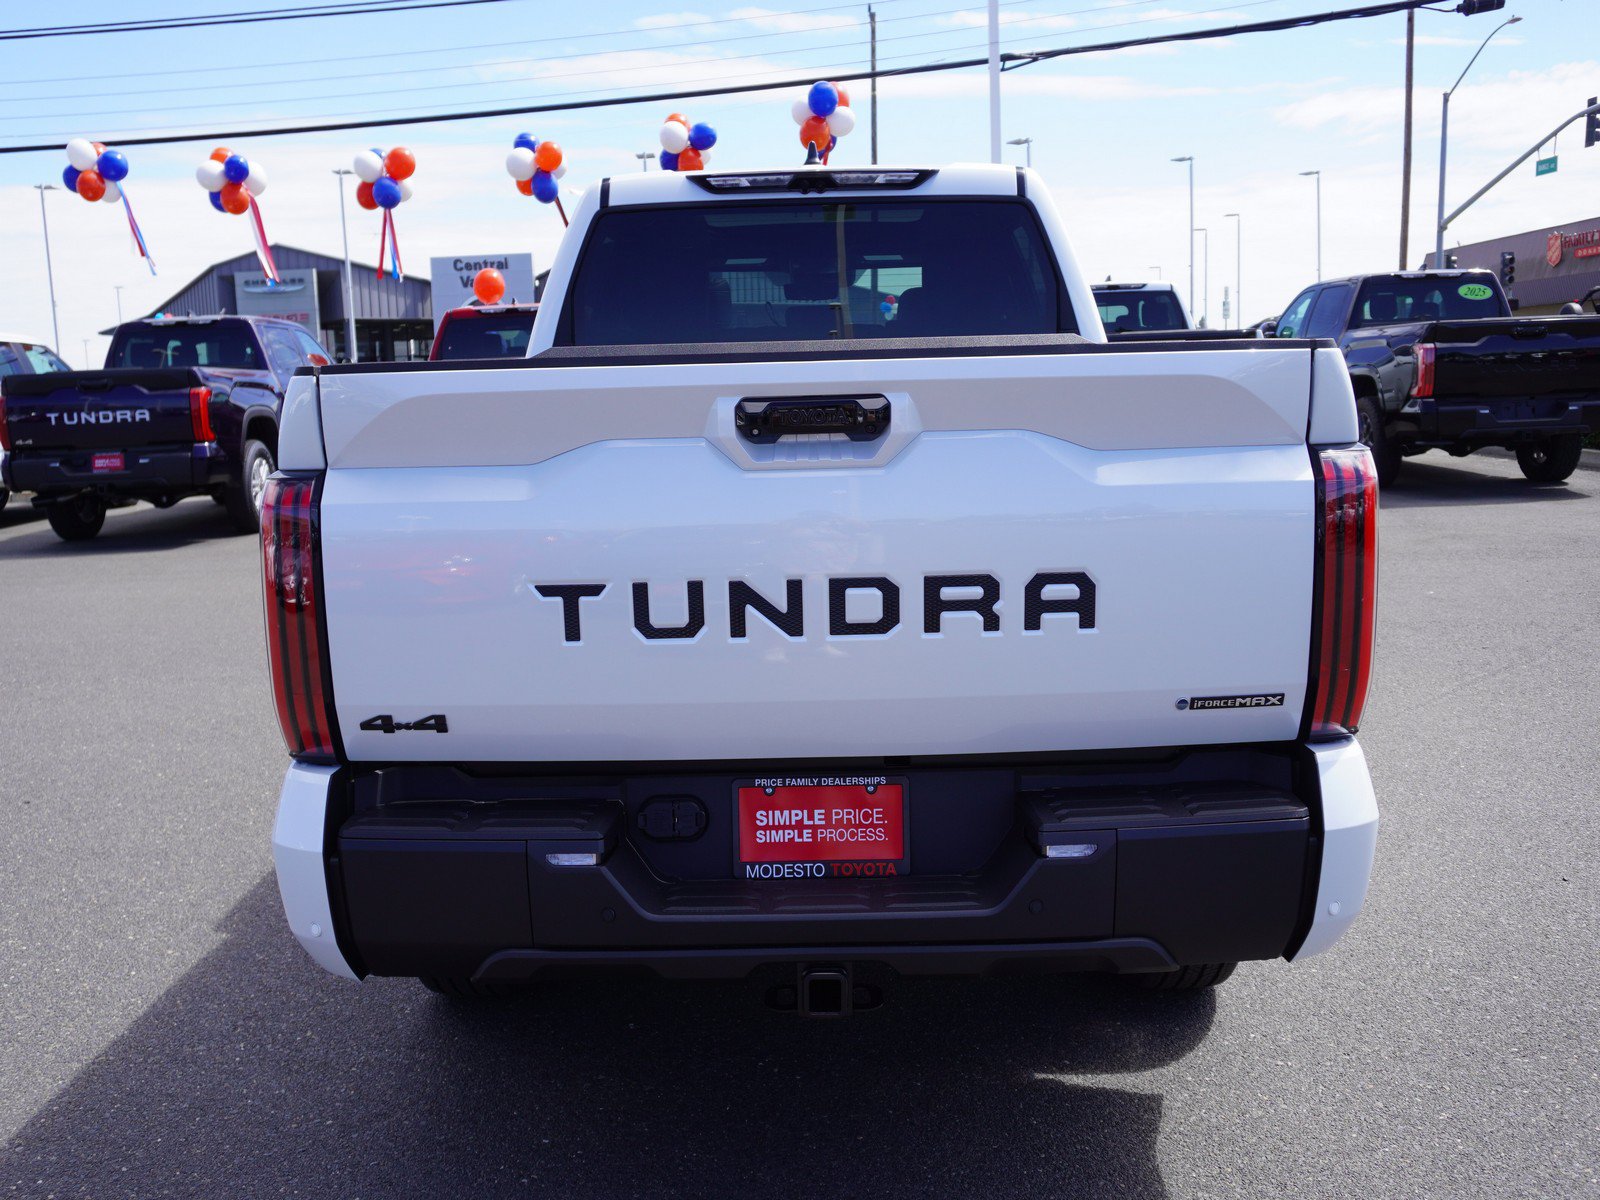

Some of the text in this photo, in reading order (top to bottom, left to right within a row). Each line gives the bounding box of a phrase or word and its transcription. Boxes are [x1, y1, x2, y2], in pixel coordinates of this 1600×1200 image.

[453, 257, 509, 271] Central
[1464, 286, 1487, 297] 2025
[46, 409, 150, 426] TUNDRA
[777, 408, 848, 424] TOYOTA
[530, 568, 1098, 643] TUNDRA
[755, 776, 887, 787] PRICE FAMILY DEALERSHIPS
[755, 808, 888, 827] SIMPLE PRICE.
[756, 828, 888, 843] SIMPLE PROCESS.
[746, 862, 897, 879] MODESTO TOYOTA
